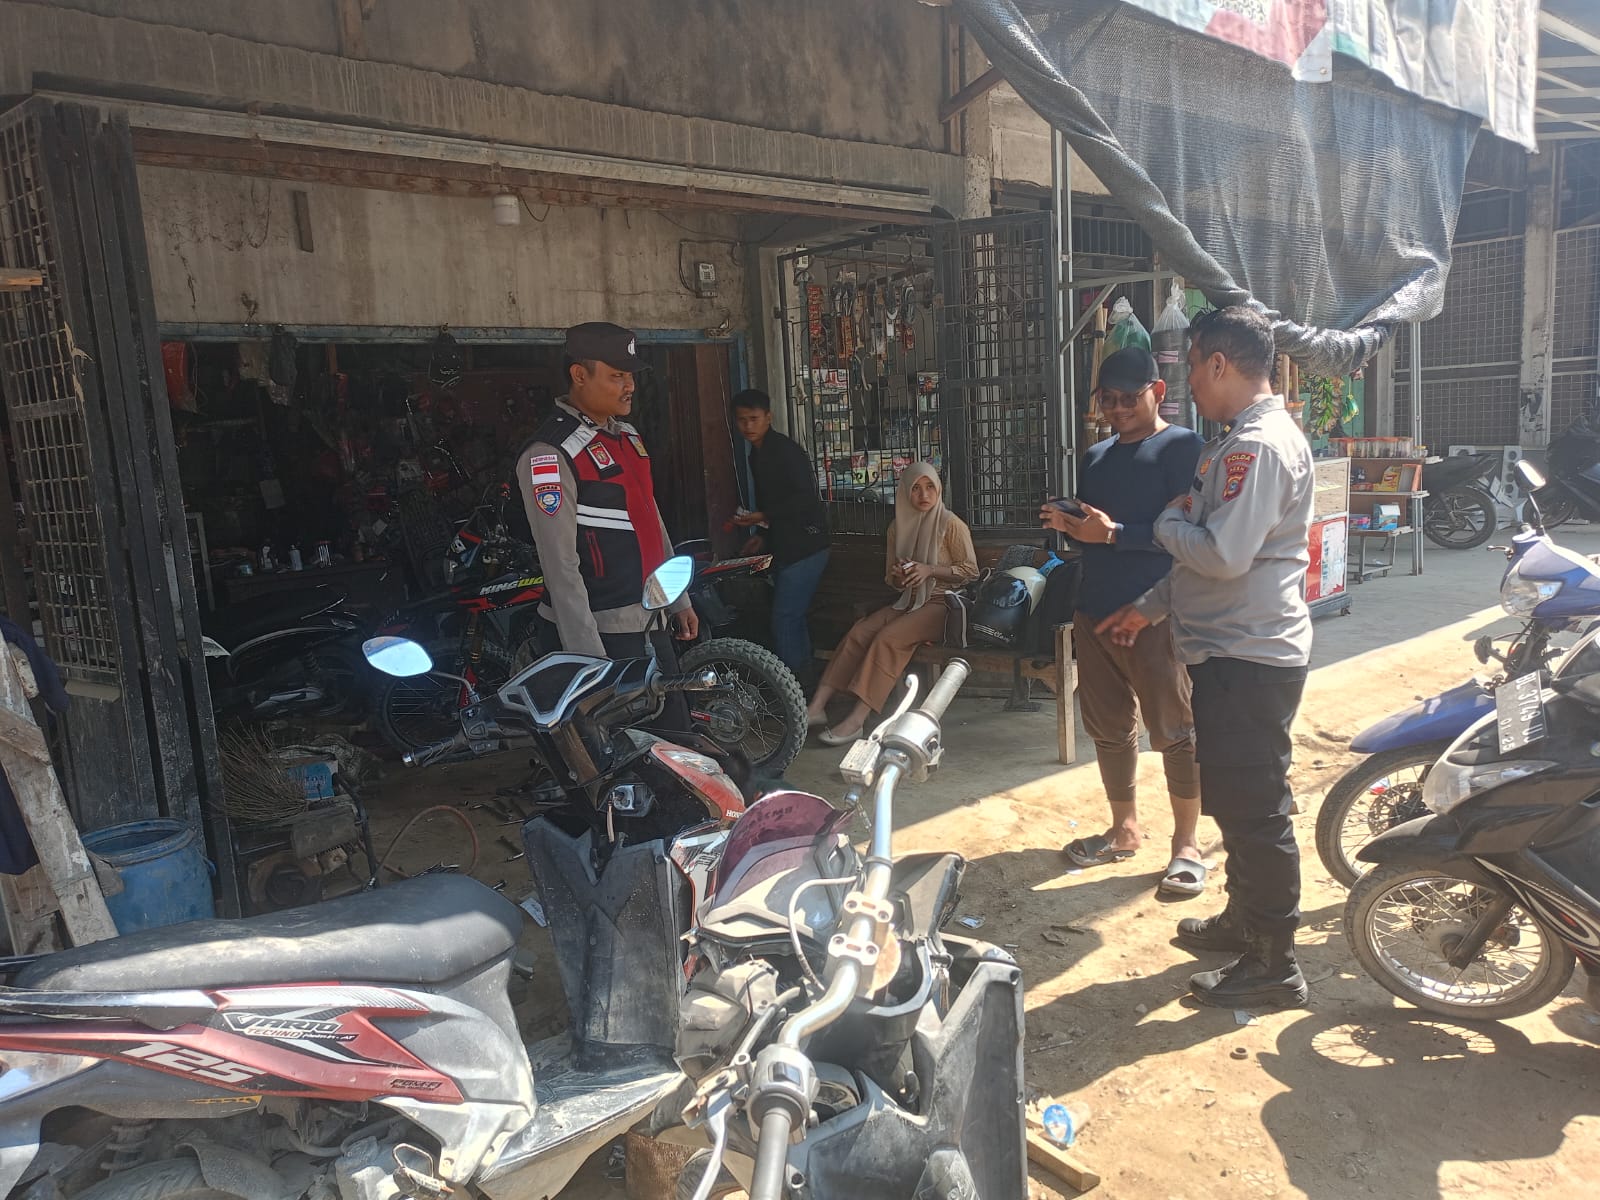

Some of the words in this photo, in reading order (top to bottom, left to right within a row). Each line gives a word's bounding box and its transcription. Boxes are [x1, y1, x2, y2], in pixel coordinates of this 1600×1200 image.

[1227, 454, 1251, 463] POLDA
[1515, 671, 1537, 690] BL
[1518, 689, 1541, 722] 3749
[1522, 723, 1544, 743] UJ
[725, 809, 743, 818] HON
[223, 1011, 342, 1033] VARIO
[246, 1028, 302, 1038] TECHNO
[119, 1041, 268, 1083] 125
